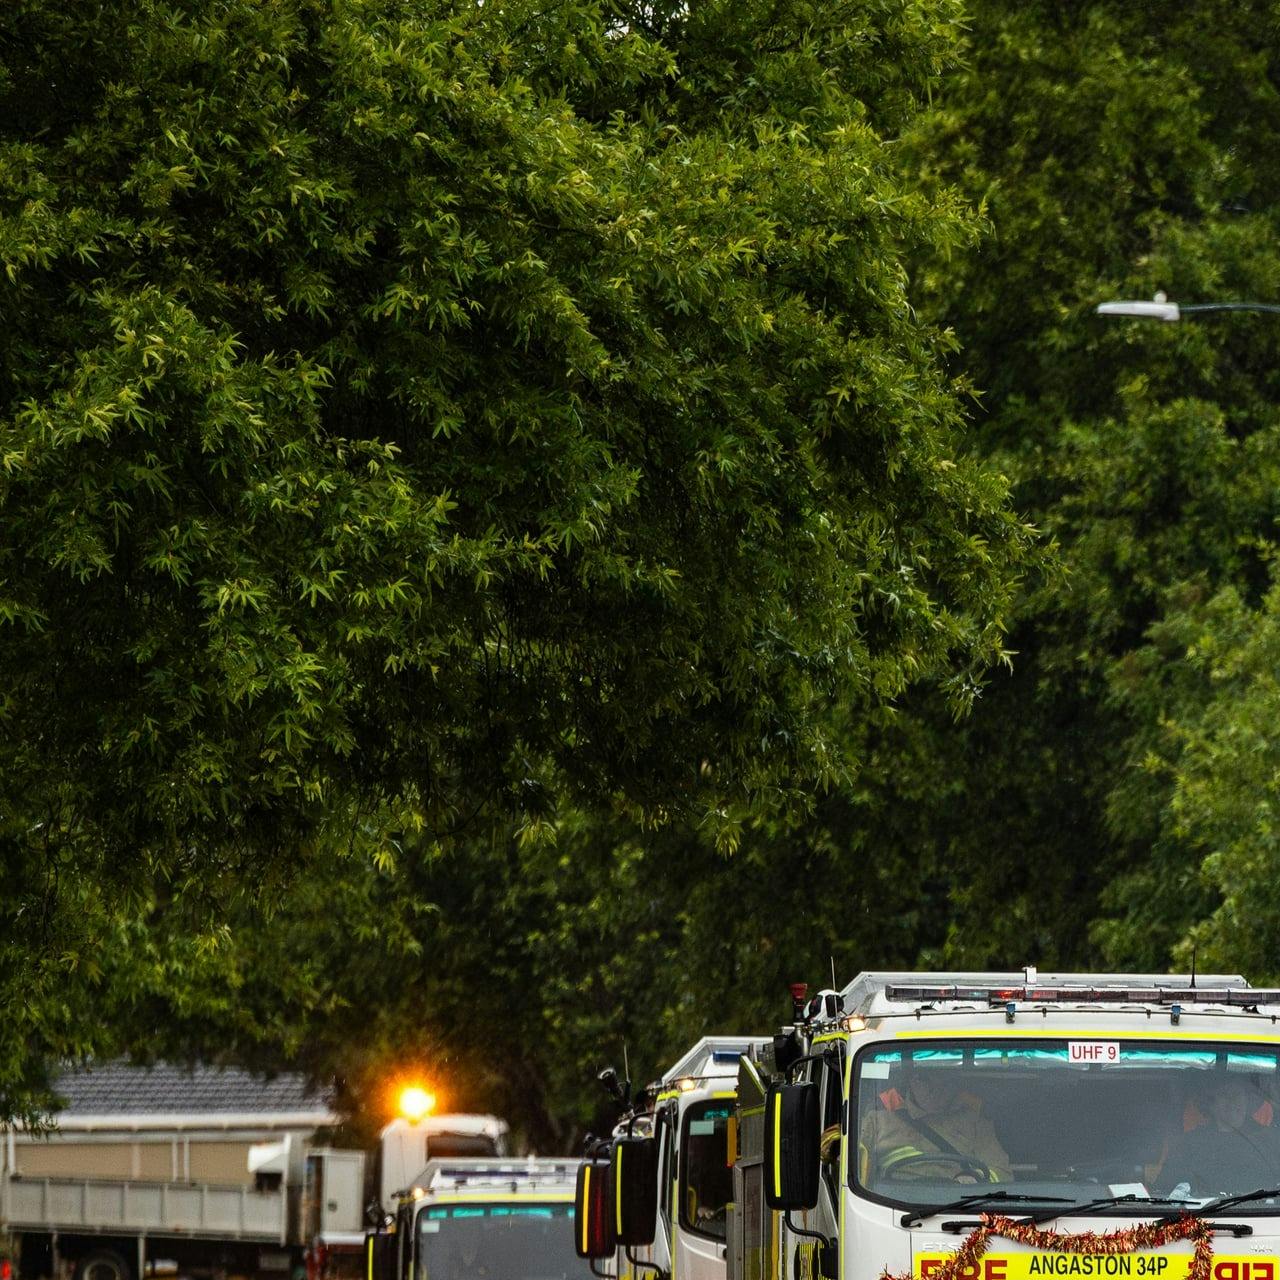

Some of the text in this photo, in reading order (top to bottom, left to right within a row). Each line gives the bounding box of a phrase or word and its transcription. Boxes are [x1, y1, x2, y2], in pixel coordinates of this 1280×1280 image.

[1072, 1045, 1117, 1060] UHF 9
[1029, 1255, 1131, 1276] ANGASTON
[1136, 1256, 1168, 1276] 34P
